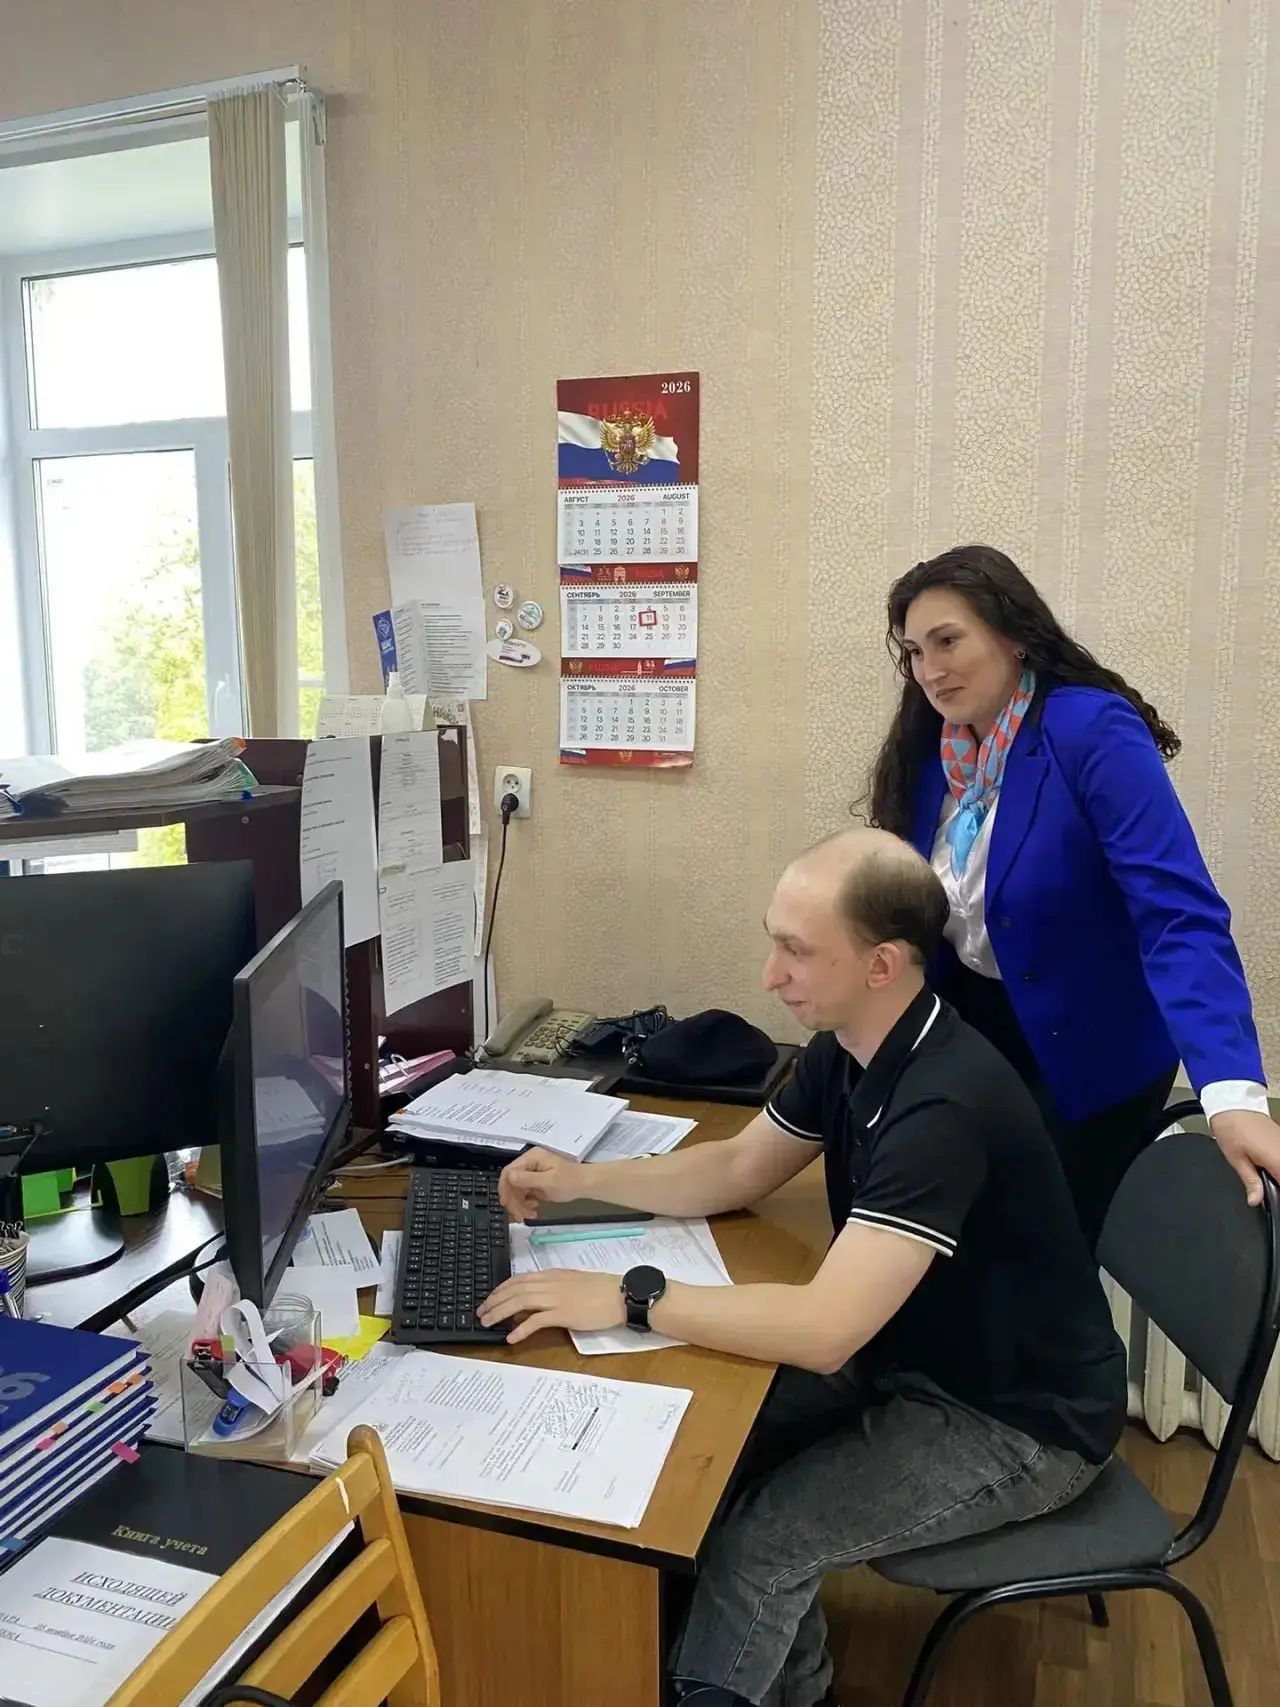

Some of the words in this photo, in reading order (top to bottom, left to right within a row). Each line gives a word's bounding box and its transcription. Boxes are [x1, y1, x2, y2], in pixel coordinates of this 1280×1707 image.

[661, 381, 691, 394] 2026
[629, 614, 637, 622] 10
[595, 733, 603, 741] 27
[110, 1525, 160, 1544] Книга
[160, 1538, 208, 1555] учета
[70, 1572, 188, 1605] ИСХОДЯЩЕЙ
